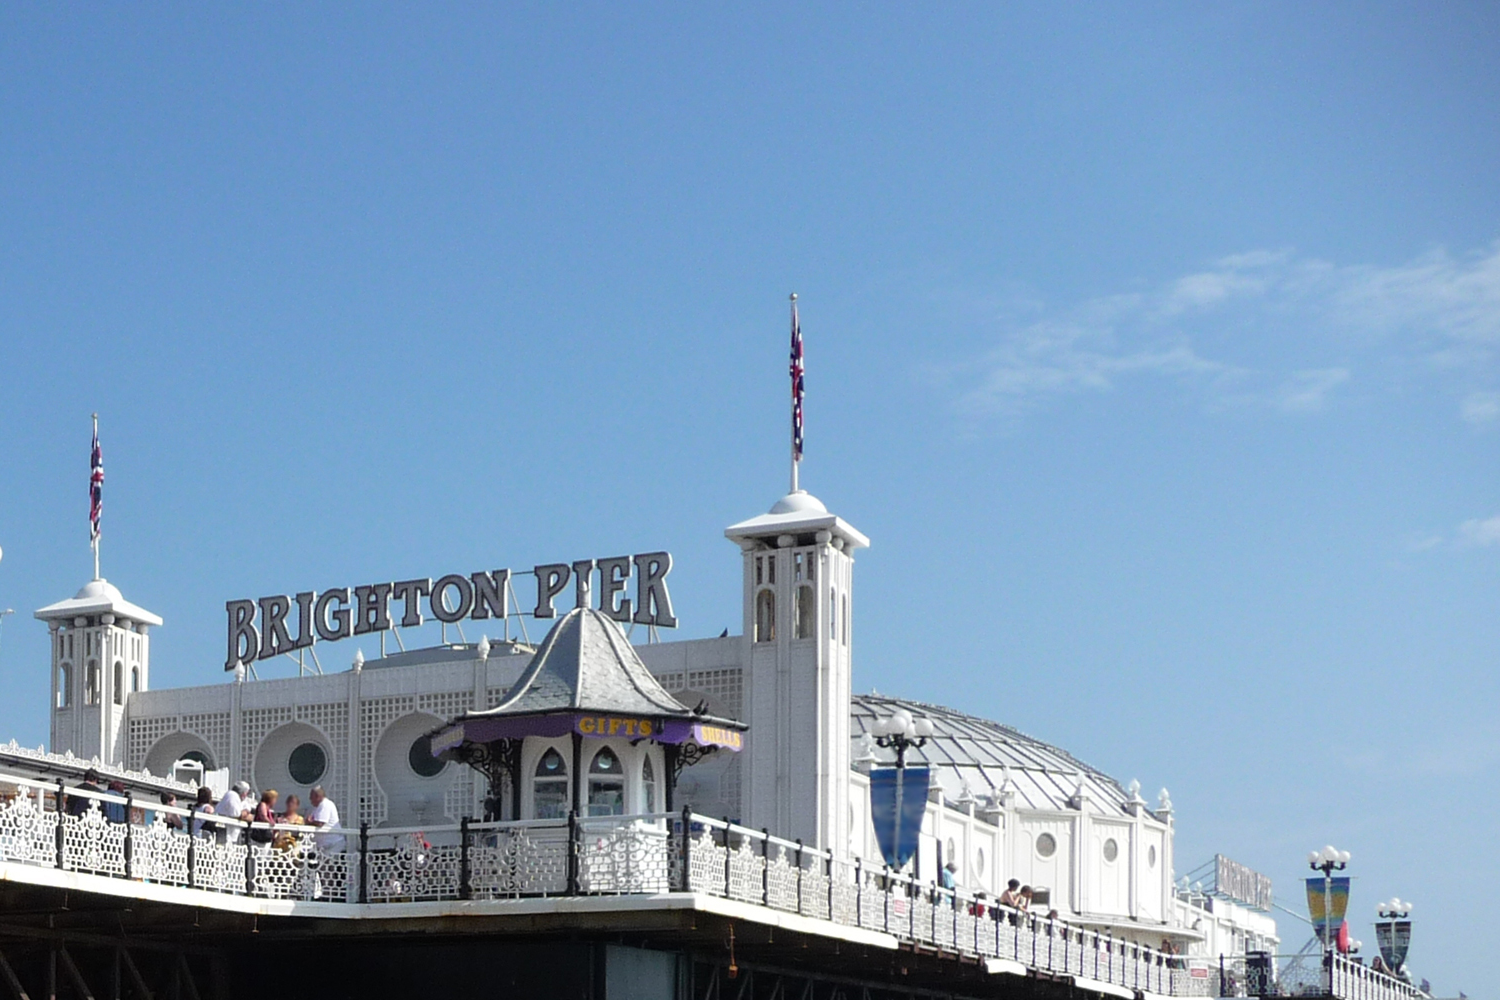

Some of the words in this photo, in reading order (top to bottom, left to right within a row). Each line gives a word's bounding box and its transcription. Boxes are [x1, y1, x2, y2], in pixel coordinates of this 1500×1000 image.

[224, 568, 510, 672] BRIGHTON
[534, 551, 678, 628] PIER
[579, 716, 652, 736] GIFTS
[702, 725, 741, 748] SHELLS
